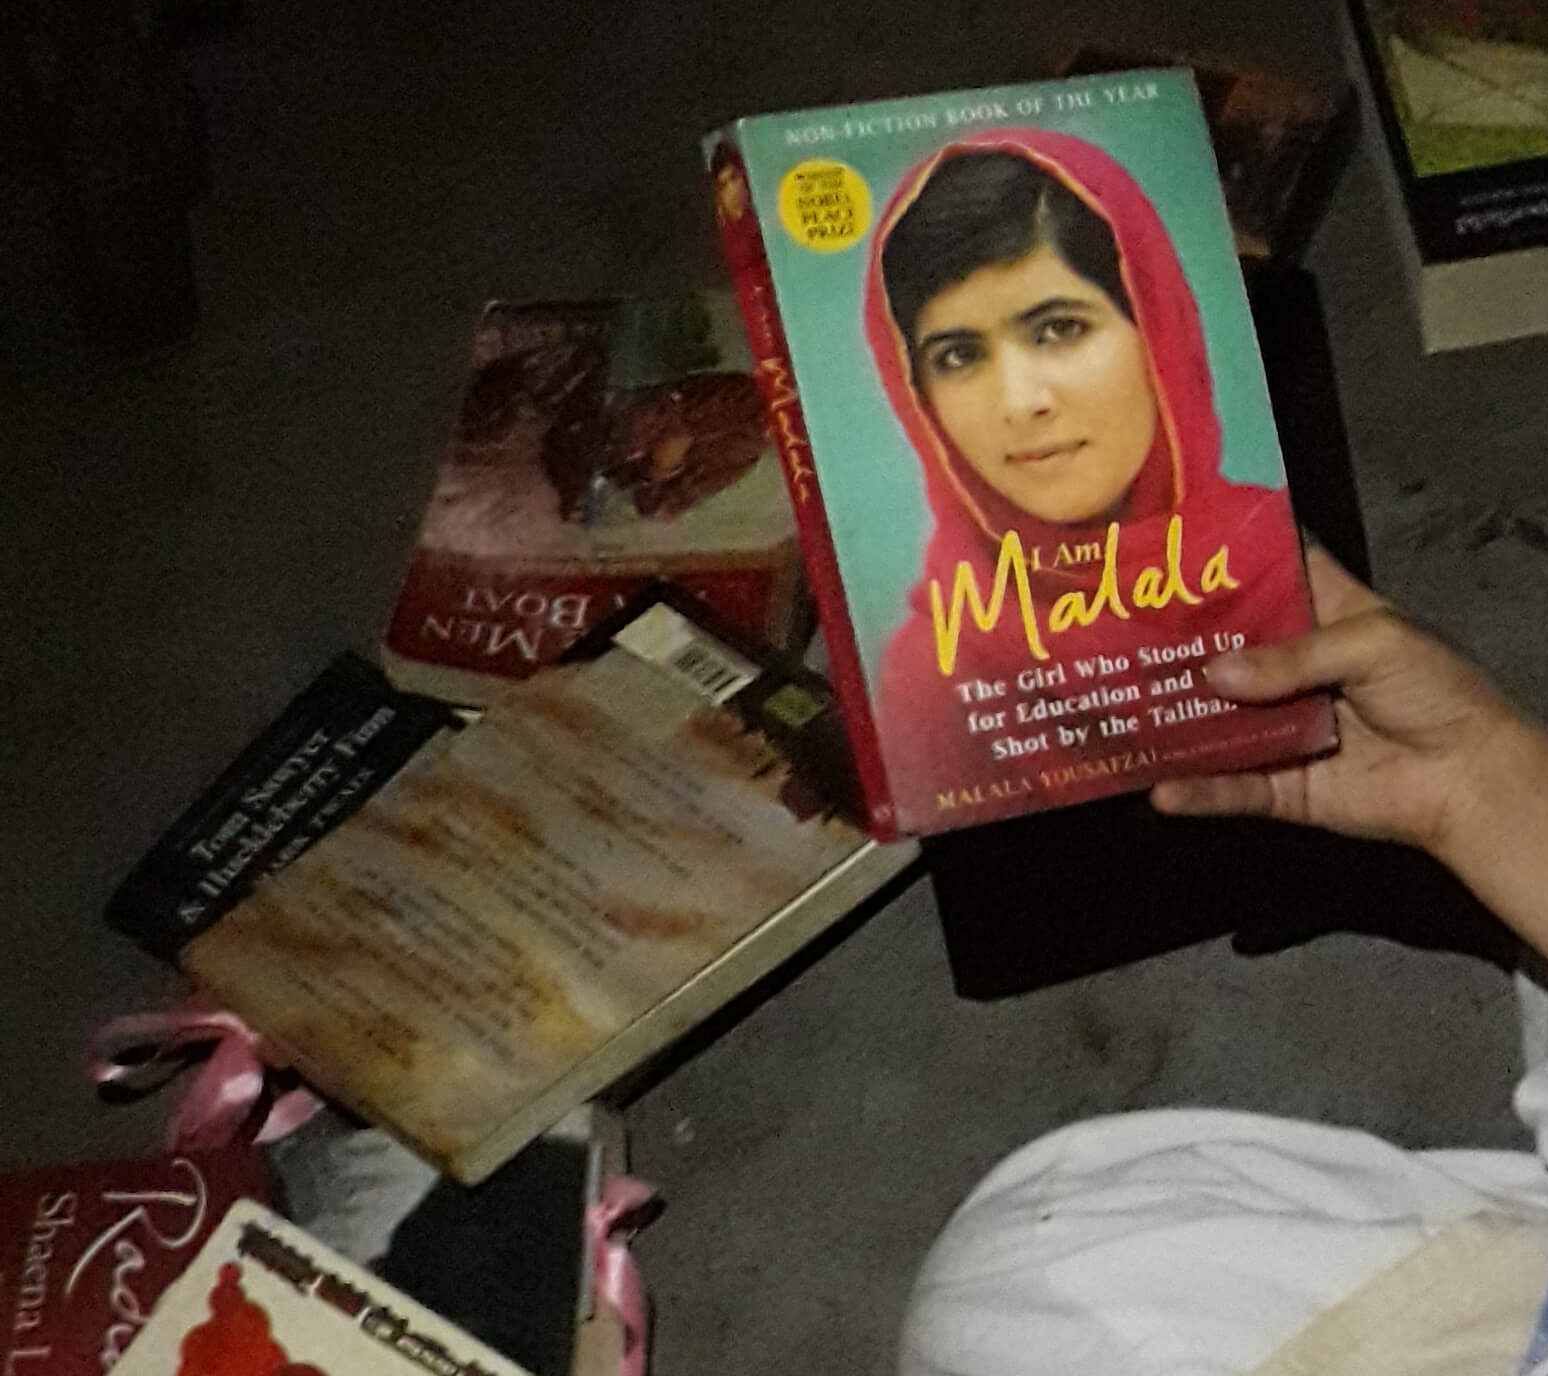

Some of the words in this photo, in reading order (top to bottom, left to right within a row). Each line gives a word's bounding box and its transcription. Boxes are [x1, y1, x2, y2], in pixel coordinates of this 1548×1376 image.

[945, 96, 1010, 127] BOOK
[1016, 95, 1044, 116] OF
[1103, 81, 1160, 106] YEAR
[1031, 545, 1043, 572] I
[1053, 541, 1101, 568] Am
[463, 587, 593, 628] BOAT
[929, 514, 1241, 676] Malala
[421, 615, 542, 661] MEN
[956, 679, 1007, 705] The
[1016, 663, 1069, 692] Girl
[1073, 656, 1131, 681] Who
[1137, 640, 1207, 667] Stood
[1213, 632, 1247, 658] Up
[966, 711, 1007, 735] for
[1015, 683, 1143, 724] Education
[1150, 669, 1195, 697] and
[990, 735, 1050, 762] Shot
[1058, 725, 1091, 750] by
[1098, 713, 1141, 739] the
[935, 776, 1034, 812] MALALA
[13, 1190, 78, 1332] Shaena
